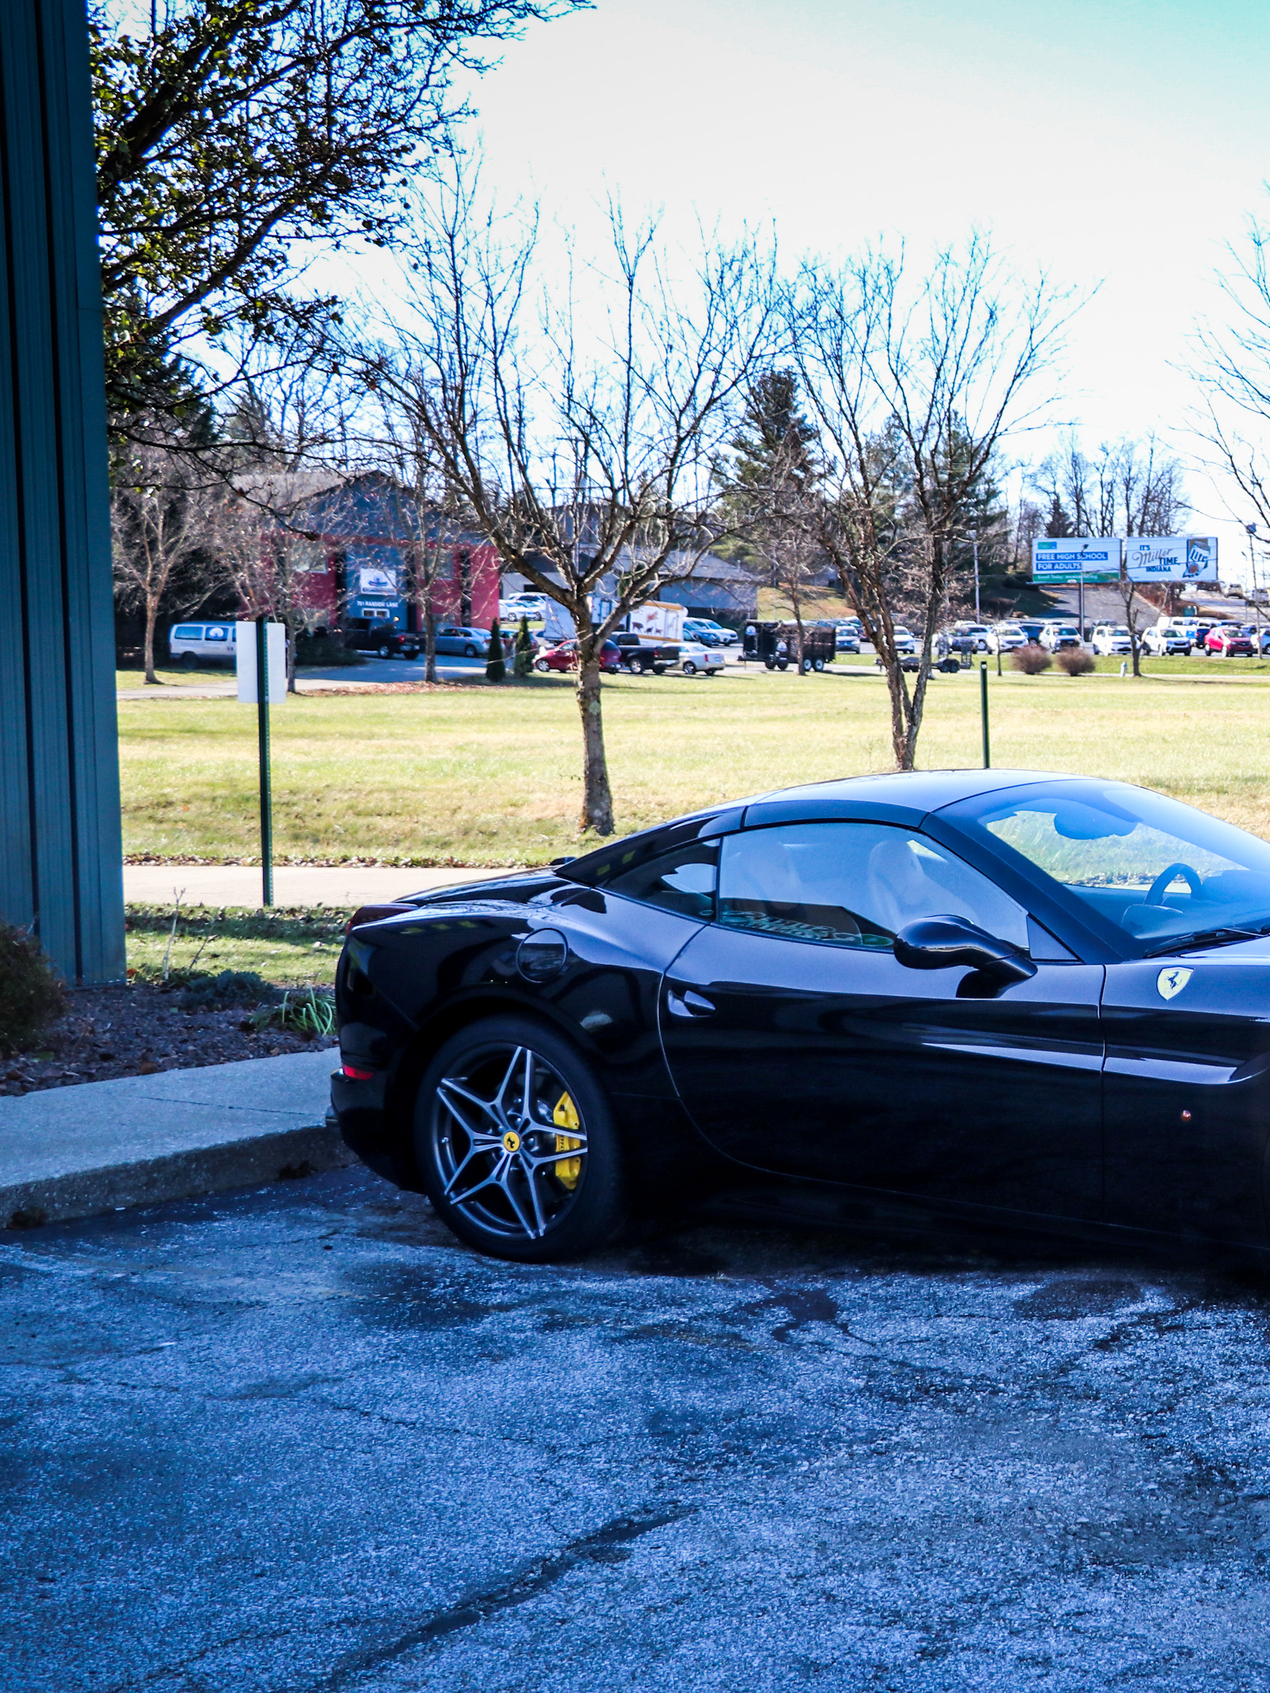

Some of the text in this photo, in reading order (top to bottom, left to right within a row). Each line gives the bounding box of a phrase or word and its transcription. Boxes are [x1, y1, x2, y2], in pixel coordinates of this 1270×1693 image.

[1077, 552, 1106, 560] SCHOOL
[1132, 548, 1173, 567] Miller
[1054, 562, 1081, 570] ADULTS
